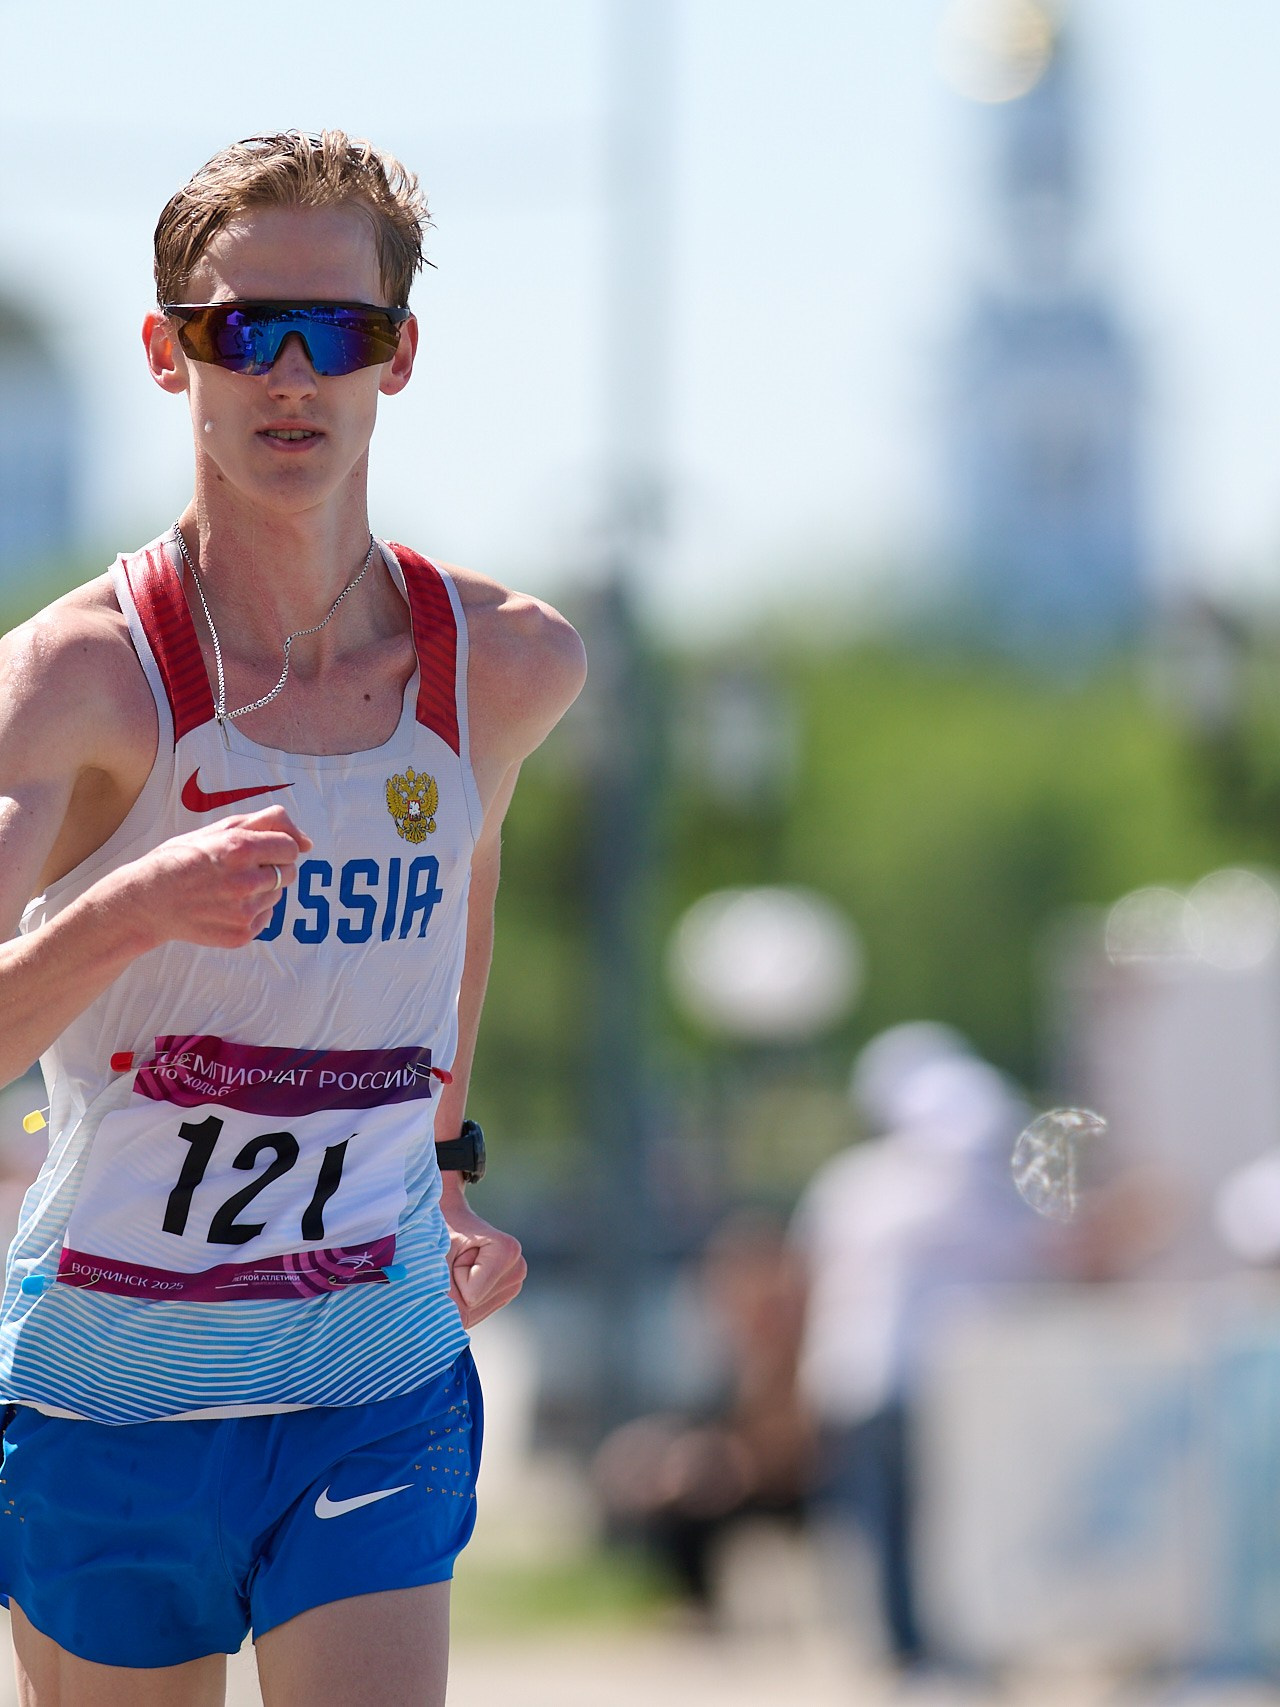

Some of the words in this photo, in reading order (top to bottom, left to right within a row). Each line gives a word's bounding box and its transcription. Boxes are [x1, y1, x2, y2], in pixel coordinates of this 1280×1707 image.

[253, 855, 443, 944] SSIA
[318, 1068, 418, 1091] РОССИИ
[162, 1115, 360, 1245] 121
[71, 1262, 149, 1287] ВОТКИНСК
[151, 1279, 185, 1290] 2025
[261, 1274, 301, 1282] АТЛЕТИКИ
